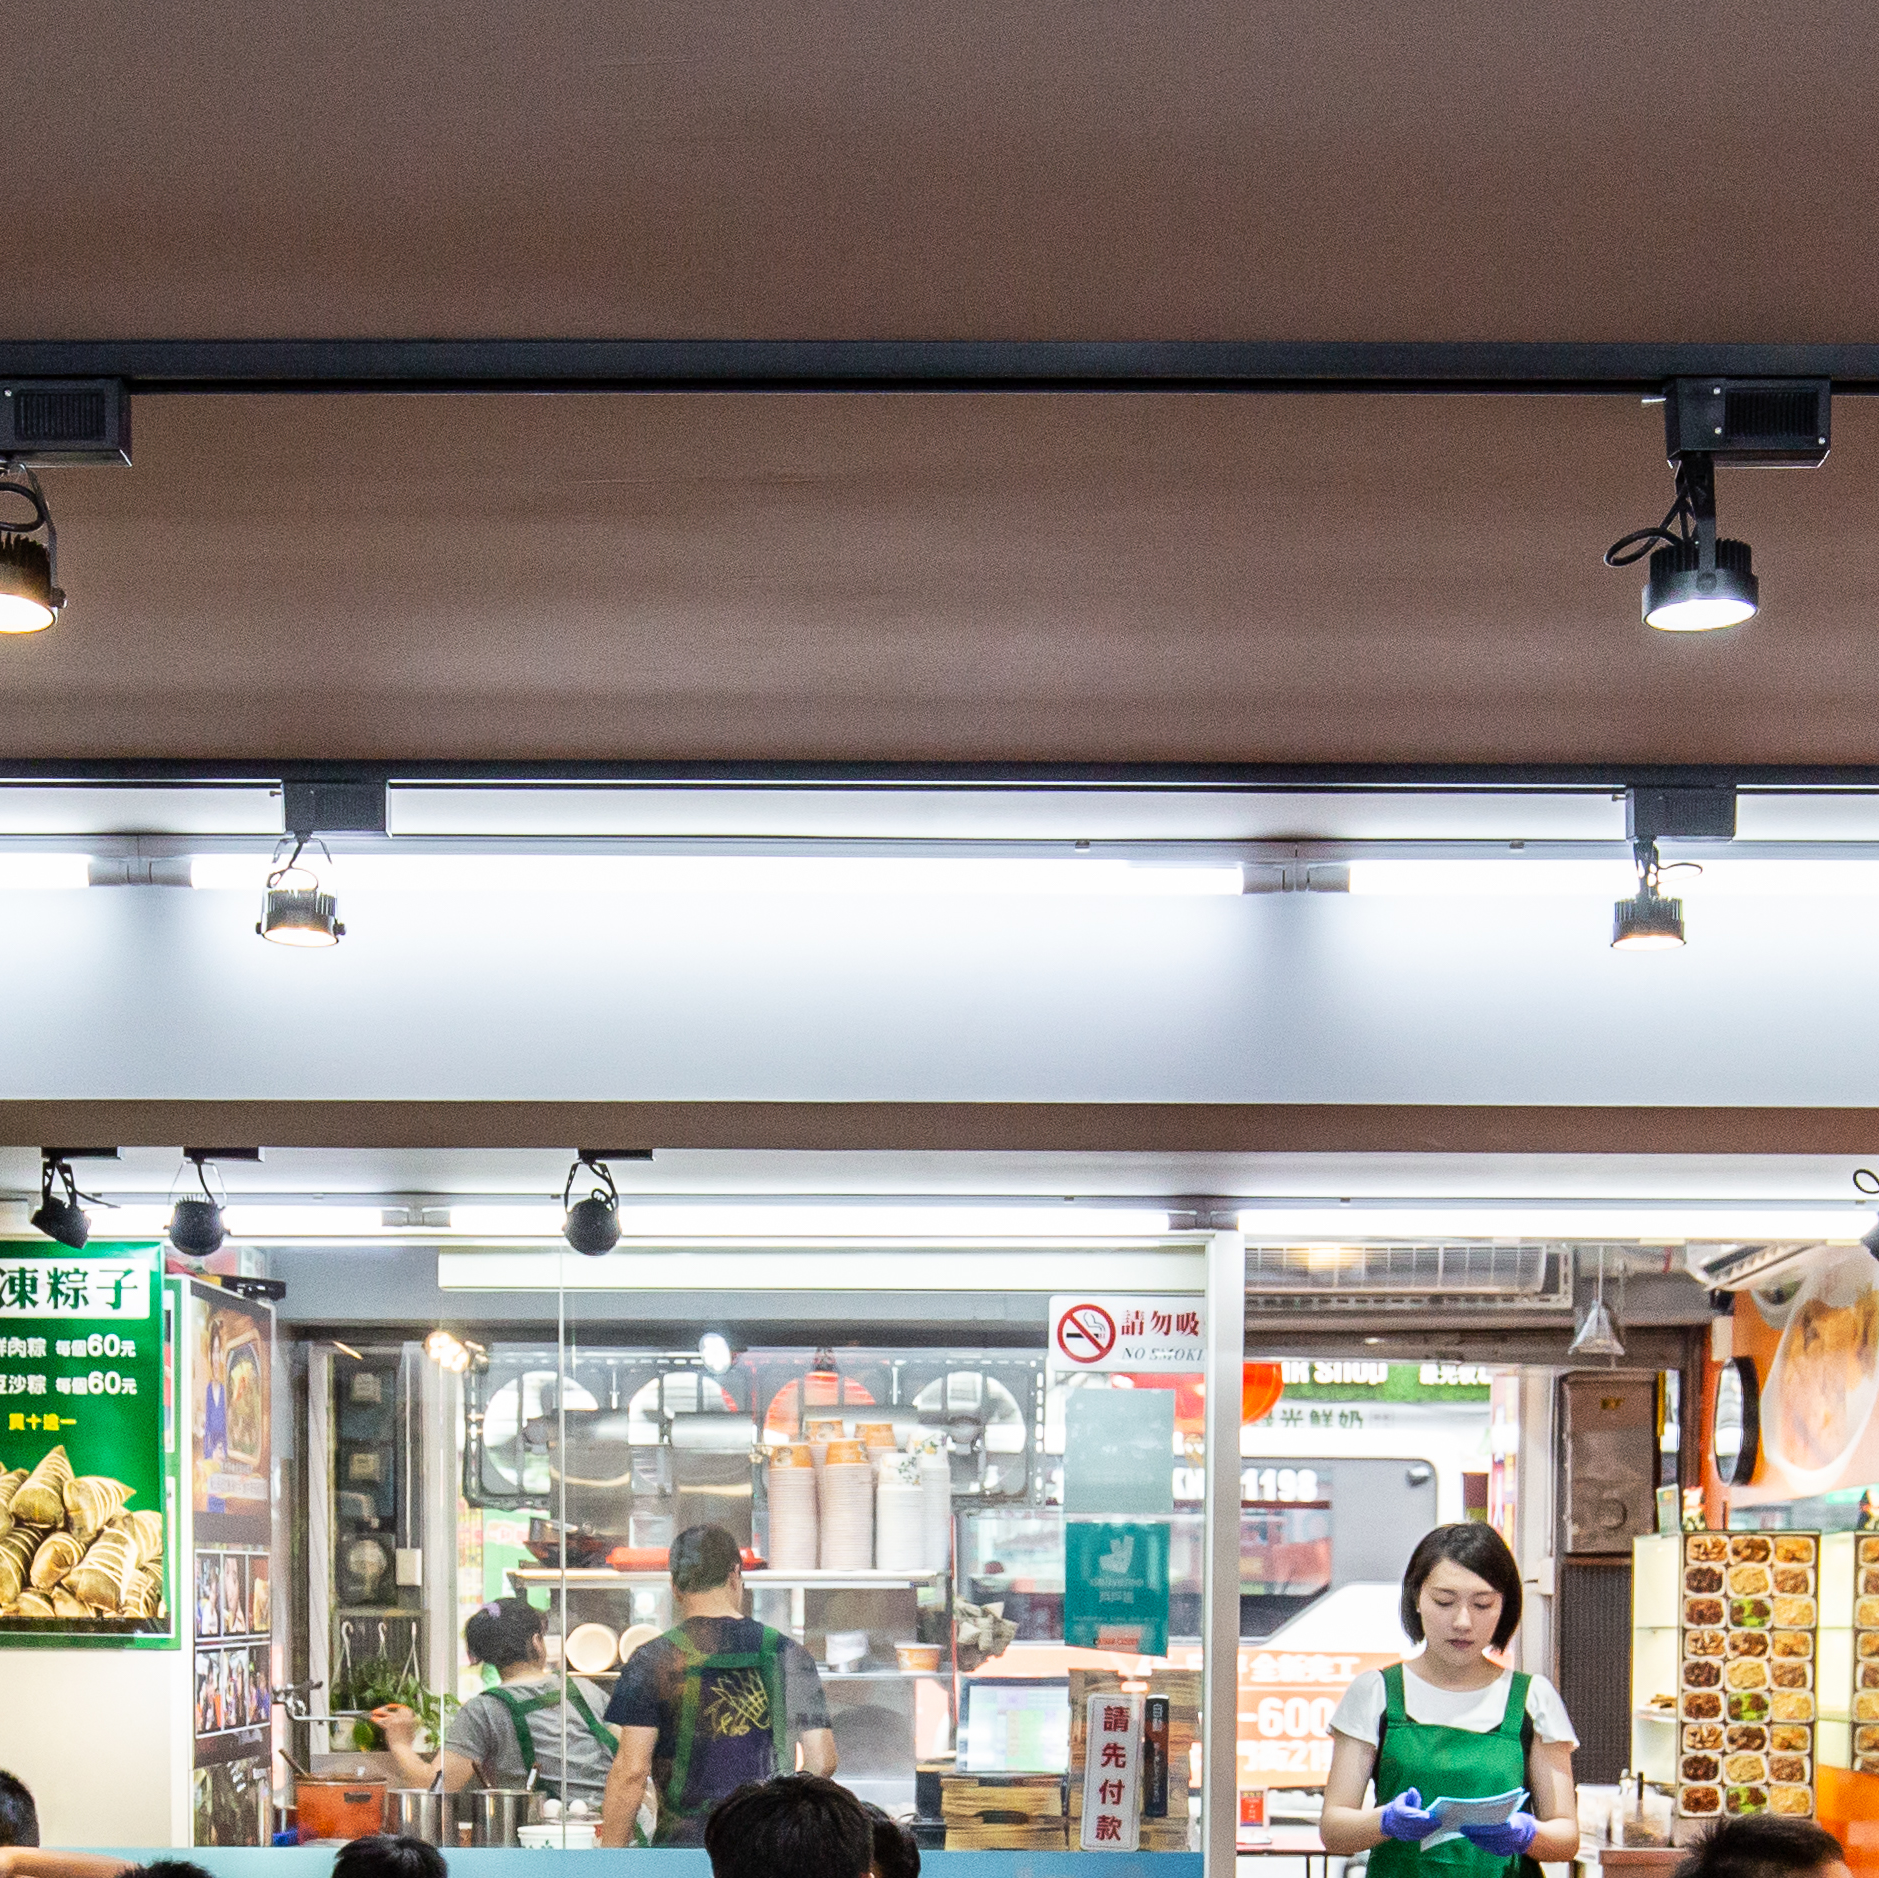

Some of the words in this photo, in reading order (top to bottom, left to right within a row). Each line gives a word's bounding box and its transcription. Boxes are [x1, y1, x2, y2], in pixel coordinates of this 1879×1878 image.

[55, 1333, 138, 1358] 每個60元
[1121, 1347, 1146, 1362] NO
[55, 1370, 139, 1396] 每個60元
[1094, 1704, 1131, 1841] 請先付款
